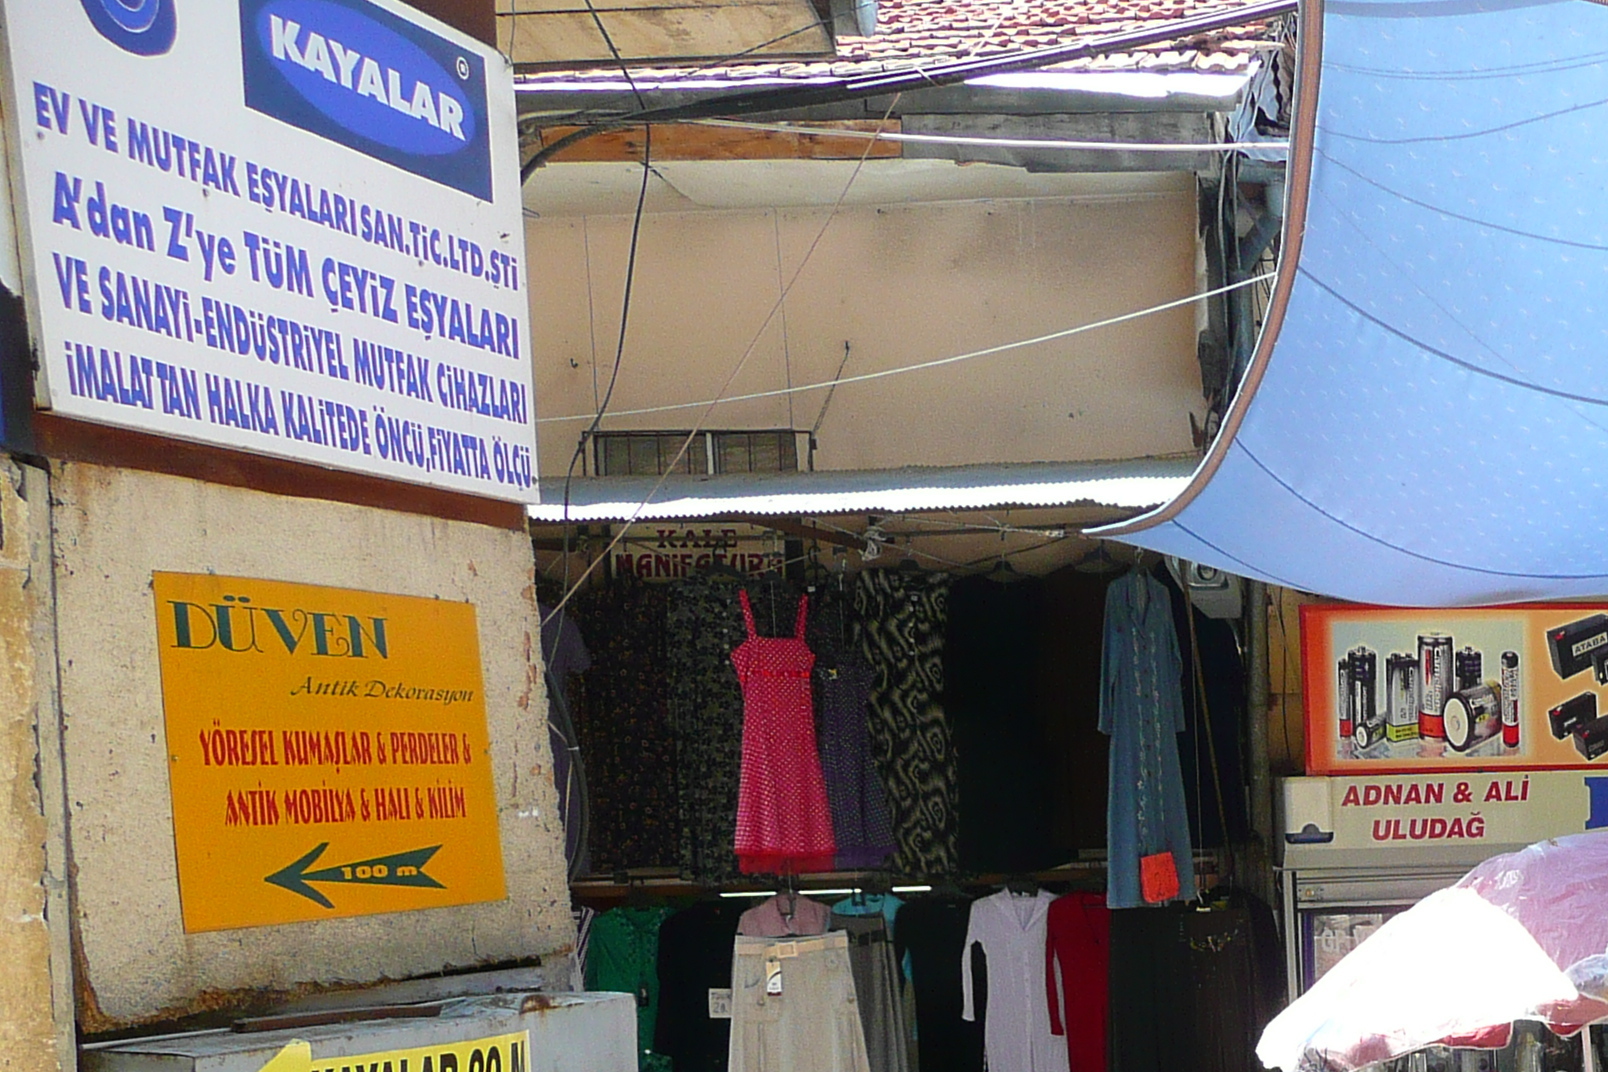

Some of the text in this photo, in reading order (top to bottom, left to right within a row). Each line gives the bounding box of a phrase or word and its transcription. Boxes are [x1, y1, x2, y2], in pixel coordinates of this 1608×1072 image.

[270, 14, 466, 141] KAYALAR
[33, 81, 70, 135] EV
[78, 98, 118, 153] VE
[128, 117, 241, 197] MUTFAK
[246, 161, 357, 236] EŞYALARI
[53, 171, 519, 359] A'dan Z'ye TÜM ÇEYİZ EŞYALARI
[52, 252, 92, 315] VE
[352, 338, 433, 402] MUTFAK
[437, 362, 527, 424] CİHAZLARI
[205, 373, 279, 436] HALKA
[281, 390, 371, 455] KALİTEDE
[492, 436, 531, 491] ÖLÇÜ
[657, 529, 737, 548] KALE
[167, 595, 388, 659] DÜVEN
[290, 676, 474, 705] Antik Dekorasyon
[199, 719, 471, 774] YÖRESEL KUMAŞLAR & PERDELER &
[225, 778, 466, 826] ANTİK MOBİLYA & HALI & KİLİM
[1342, 774, 1529, 807] ADNAN & ALİ
[1371, 809, 1485, 840] ULUDAĞ
[342, 866, 418, 878] 100 m
